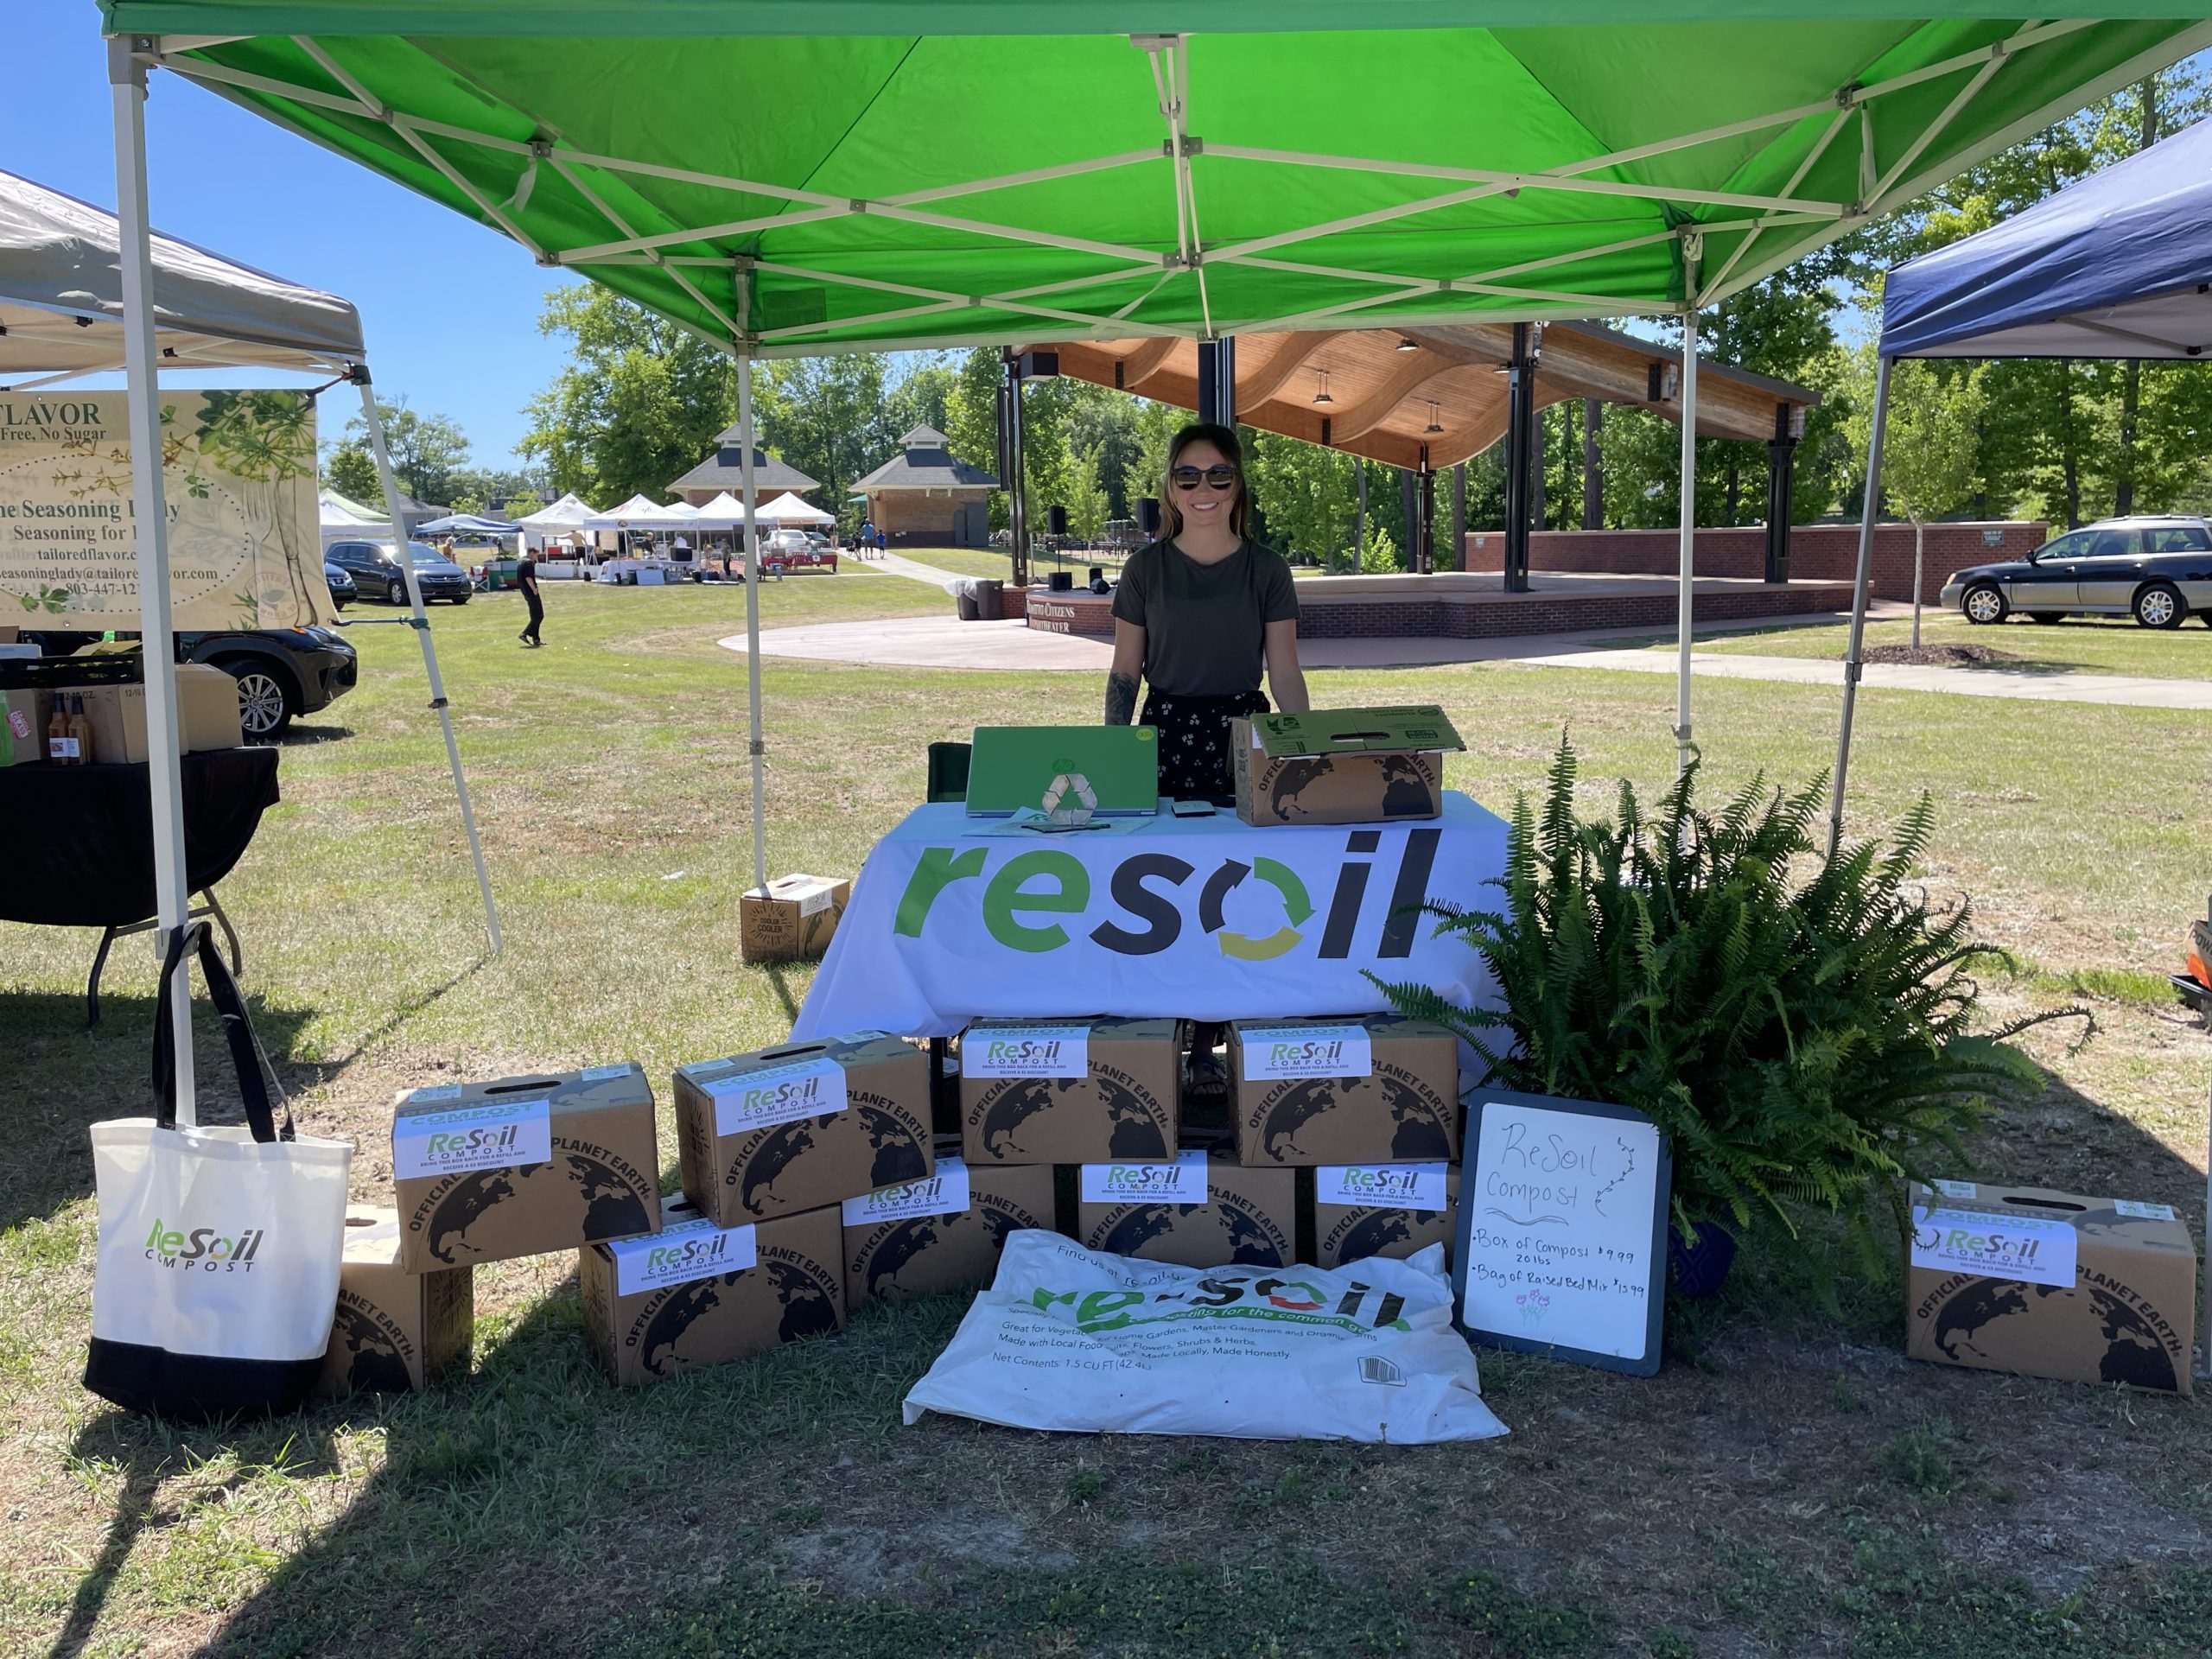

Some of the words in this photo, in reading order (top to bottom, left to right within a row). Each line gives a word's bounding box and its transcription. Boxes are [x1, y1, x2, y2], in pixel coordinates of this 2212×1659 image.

[1, 427, 35, 442] Free,
[41, 427, 60, 441] No
[64, 427, 106, 443] Sugar
[22, 499, 121, 523] Seasoning
[14, 524, 97, 544] Seasoning
[102, 524, 126, 541] for
[38, 548, 137, 562] tailoredflavor.c
[67, 583, 140, 596] 803-447-12
[12, 713, 29, 735] GLASS
[1259, 760, 1285, 791] OFFIC
[1407, 753, 1436, 784] ARTH
[893, 828, 1442, 961] resoil
[757, 925, 783, 933] COOLER
[987, 1040, 1061, 1058] ReSoil
[1270, 1040, 1343, 1061] ReSoil
[743, 1077, 819, 1110] ReSoil
[968, 1077, 1011, 1126] OFFICIAL
[1088, 1059, 1135, 1086] PLANET
[1249, 1080, 1293, 1128] OFFICIAL
[1371, 1059, 1420, 1086] PLANET
[744, 1096, 818, 1116] COMPOST
[426, 1125, 518, 1154] ReSoil
[725, 1126, 770, 1186] OFFICIAL
[847, 1090, 895, 1111] PLANET
[1501, 1122, 1597, 1177] ReSoil
[428, 1145, 516, 1161] COMPOST
[409, 1168, 461, 1232] OFFICIAL
[551, 1136, 611, 1161] PLANET
[1107, 1166, 1181, 1184] ReSoil
[1342, 1167, 1419, 1189] ReSoil
[869, 1195, 940, 1210] COMPOST
[1344, 1185, 1416, 1196] COMPOST
[1486, 1171, 1578, 1213] Compost
[1088, 1201, 1132, 1249] OFFICIAL
[1207, 1185, 1257, 1213] PLANET
[1323, 1205, 1368, 1252] OFFICIAL
[851, 1222, 894, 1273] OFFICIAL
[969, 1191, 1019, 1213] PLANET
[1017, 1209, 1045, 1230] EAR
[1945, 1229, 2040, 1258] ReSoil
[646, 1233, 728, 1268] ReSoil
[1516, 1236, 1531, 1250] of
[1535, 1239, 1589, 1258] Compost
[1946, 1247, 2035, 1265] COMPOST
[648, 1253, 726, 1275] COMPOST
[1090, 1258, 1104, 1268] us
[1108, 1268, 1118, 1279] at
[1510, 1271, 1522, 1282] of
[1527, 1272, 1563, 1287] Raised
[1566, 1276, 1586, 1289] Bed
[1587, 1280, 1608, 1293] Mix
[1916, 1272, 1975, 1319] OFFICIAL
[2075, 1265, 2140, 1303] PLANET
[625, 1287, 673, 1347] OFFICIAL
[757, 1243, 804, 1265] PLANET
[340, 1288, 378, 1320] ANET
[377, 1311, 413, 1357] EARTH
[1007, 1307, 1049, 1319] Specially
[1146, 1325, 1189, 1339] Gardens,
[1230, 1324, 1282, 1335] Gardeners
[1221, 1306, 1244, 1318] for
[1249, 1306, 1274, 1318] the
[1278, 1312, 1345, 1325] common
[1002, 1320, 1029, 1333] Great
[1031, 1324, 1045, 1332] for
[1177, 1338, 1211, 1347] Shrubs
[998, 1333, 1027, 1346] Made
[1028, 1338, 1048, 1347] with
[1051, 1339, 1077, 1348] Local
[1173, 1347, 1210, 1357] Locally,
[1212, 1347, 1243, 1356] Made
[1245, 1348, 1292, 1359] Honestly.
[993, 1351, 1011, 1363] Net
[1065, 1358, 1080, 1369] 1.5
[1084, 1361, 1100, 1370] CU
[1103, 1359, 1114, 1371] FT
